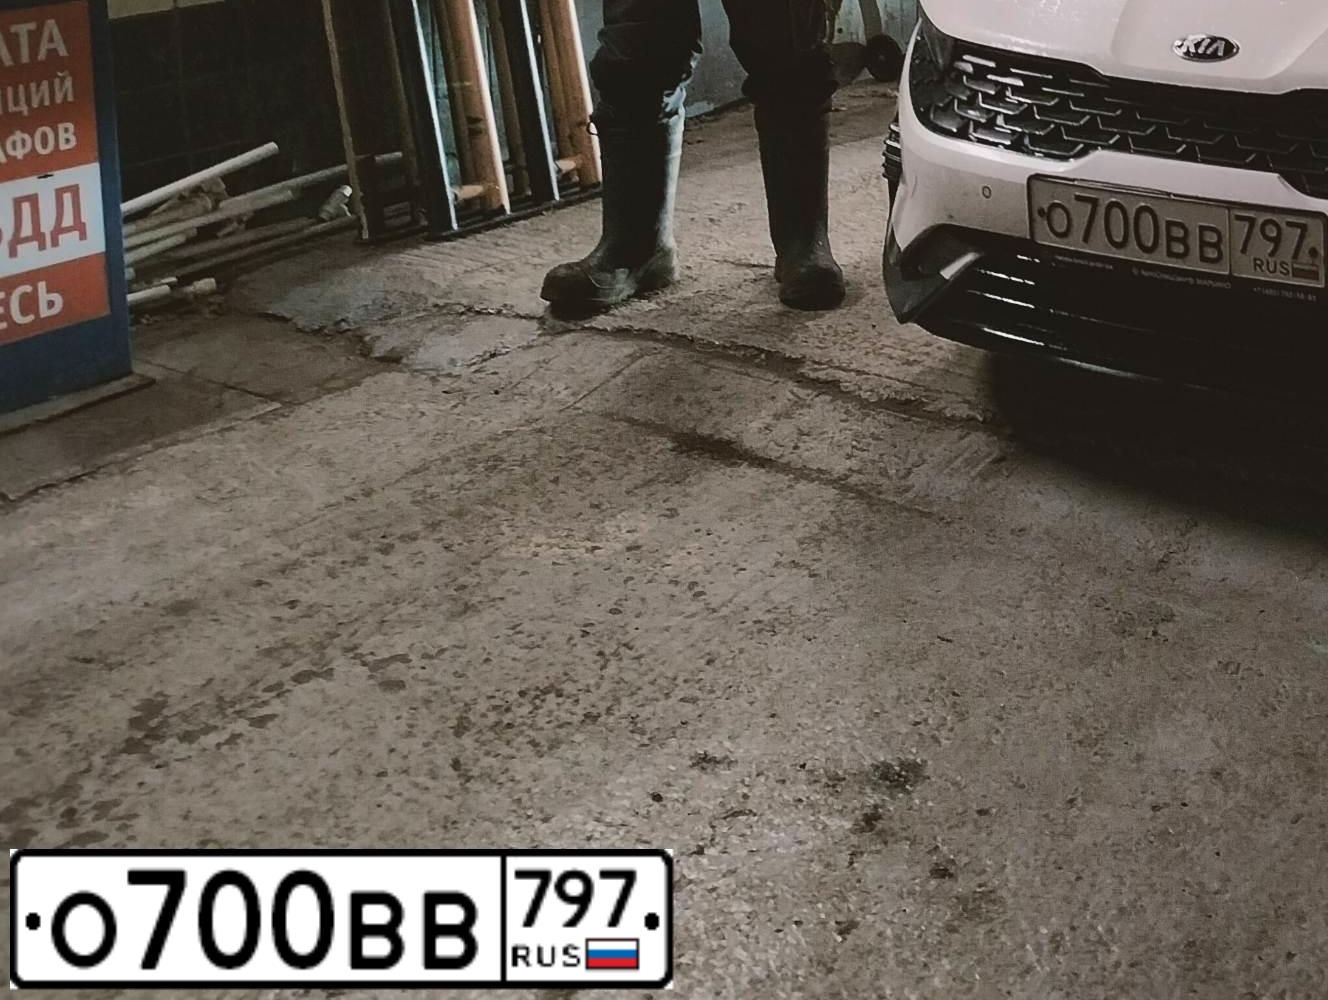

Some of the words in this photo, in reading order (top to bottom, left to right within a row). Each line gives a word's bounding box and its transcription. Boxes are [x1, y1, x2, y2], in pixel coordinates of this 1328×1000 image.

[0, 70, 74, 117] ЦИЙ
[0, 122, 77, 164] ФОВ
[0, 183, 87, 259] ДД
[1234, 214, 1308, 260] 797
[1253, 258, 1290, 276] RUS
